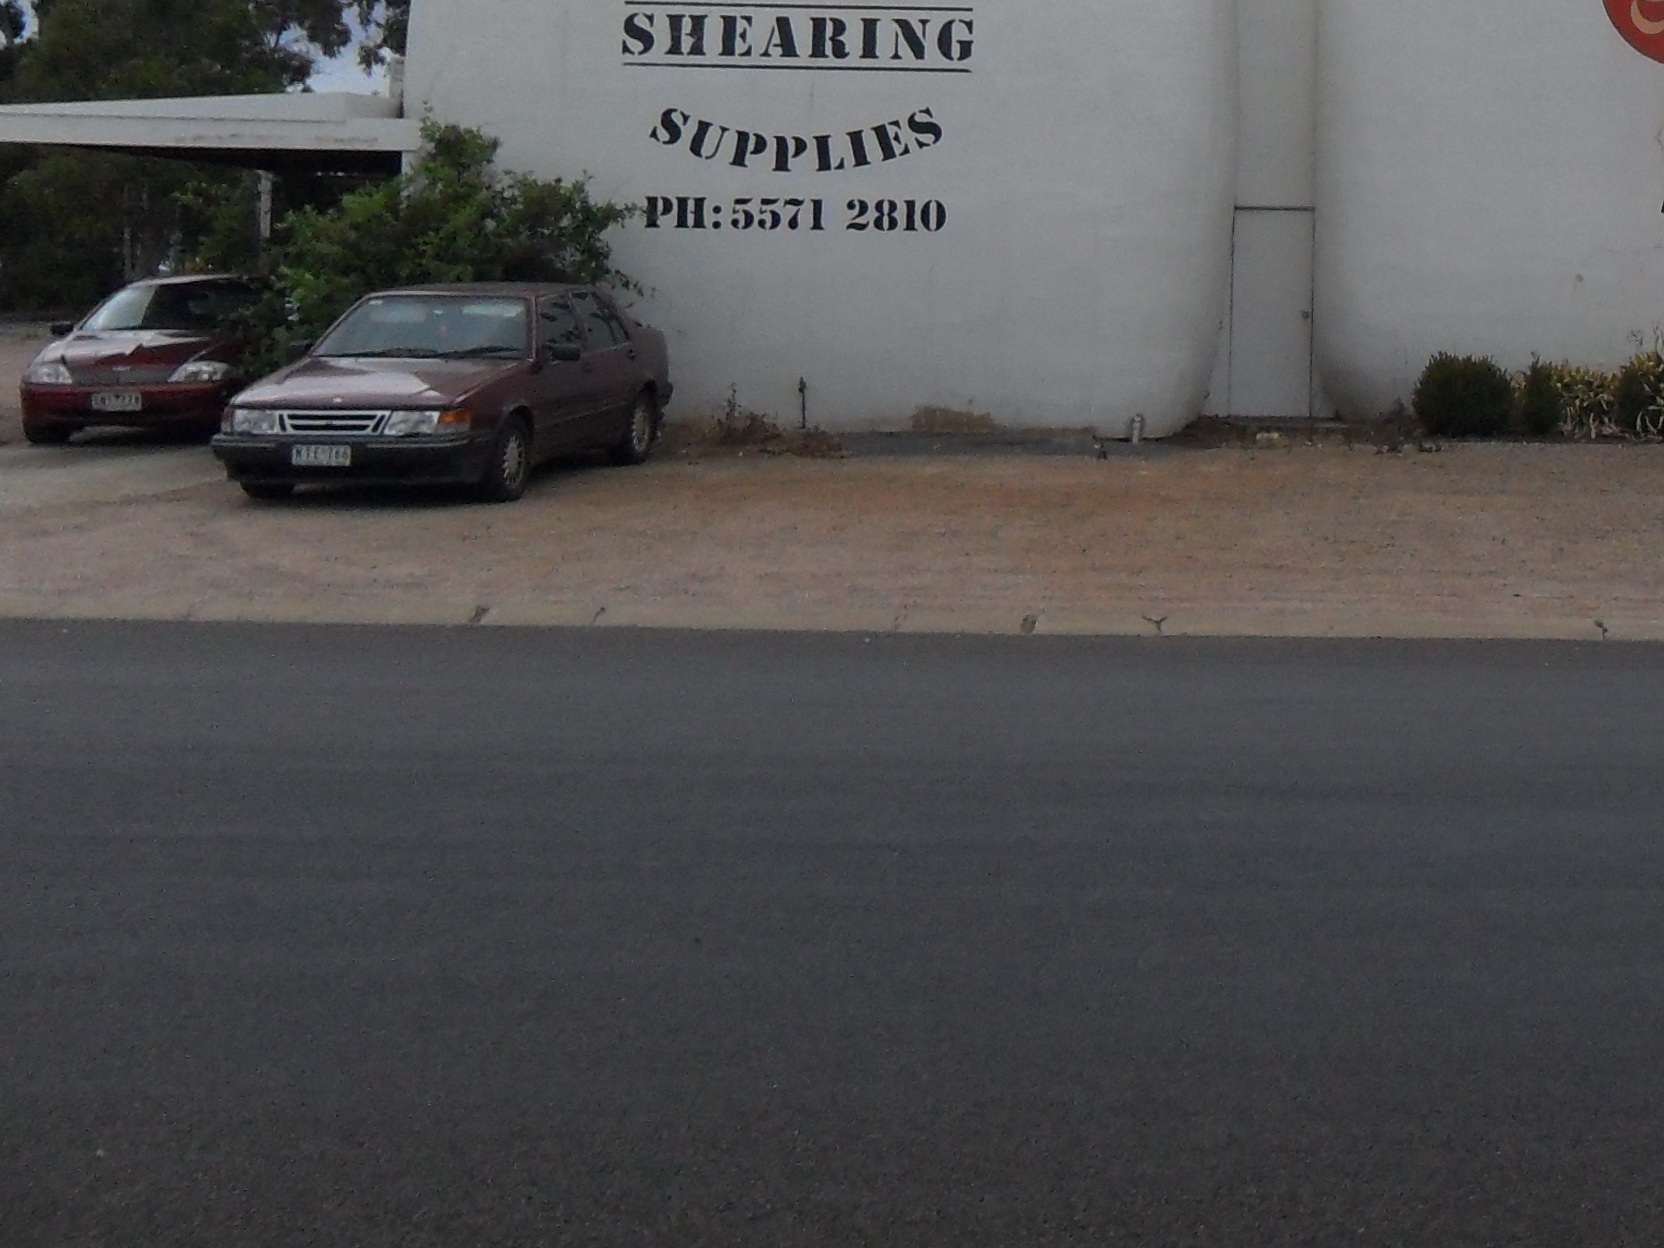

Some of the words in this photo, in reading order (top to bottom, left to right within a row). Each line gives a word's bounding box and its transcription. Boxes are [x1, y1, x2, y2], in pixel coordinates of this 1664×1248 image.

[621, 12, 975, 62] SHEARING
[649, 106, 944, 173] SUPPLIES
[644, 195, 827, 232] PH:5571
[846, 198, 948, 232] 2810
